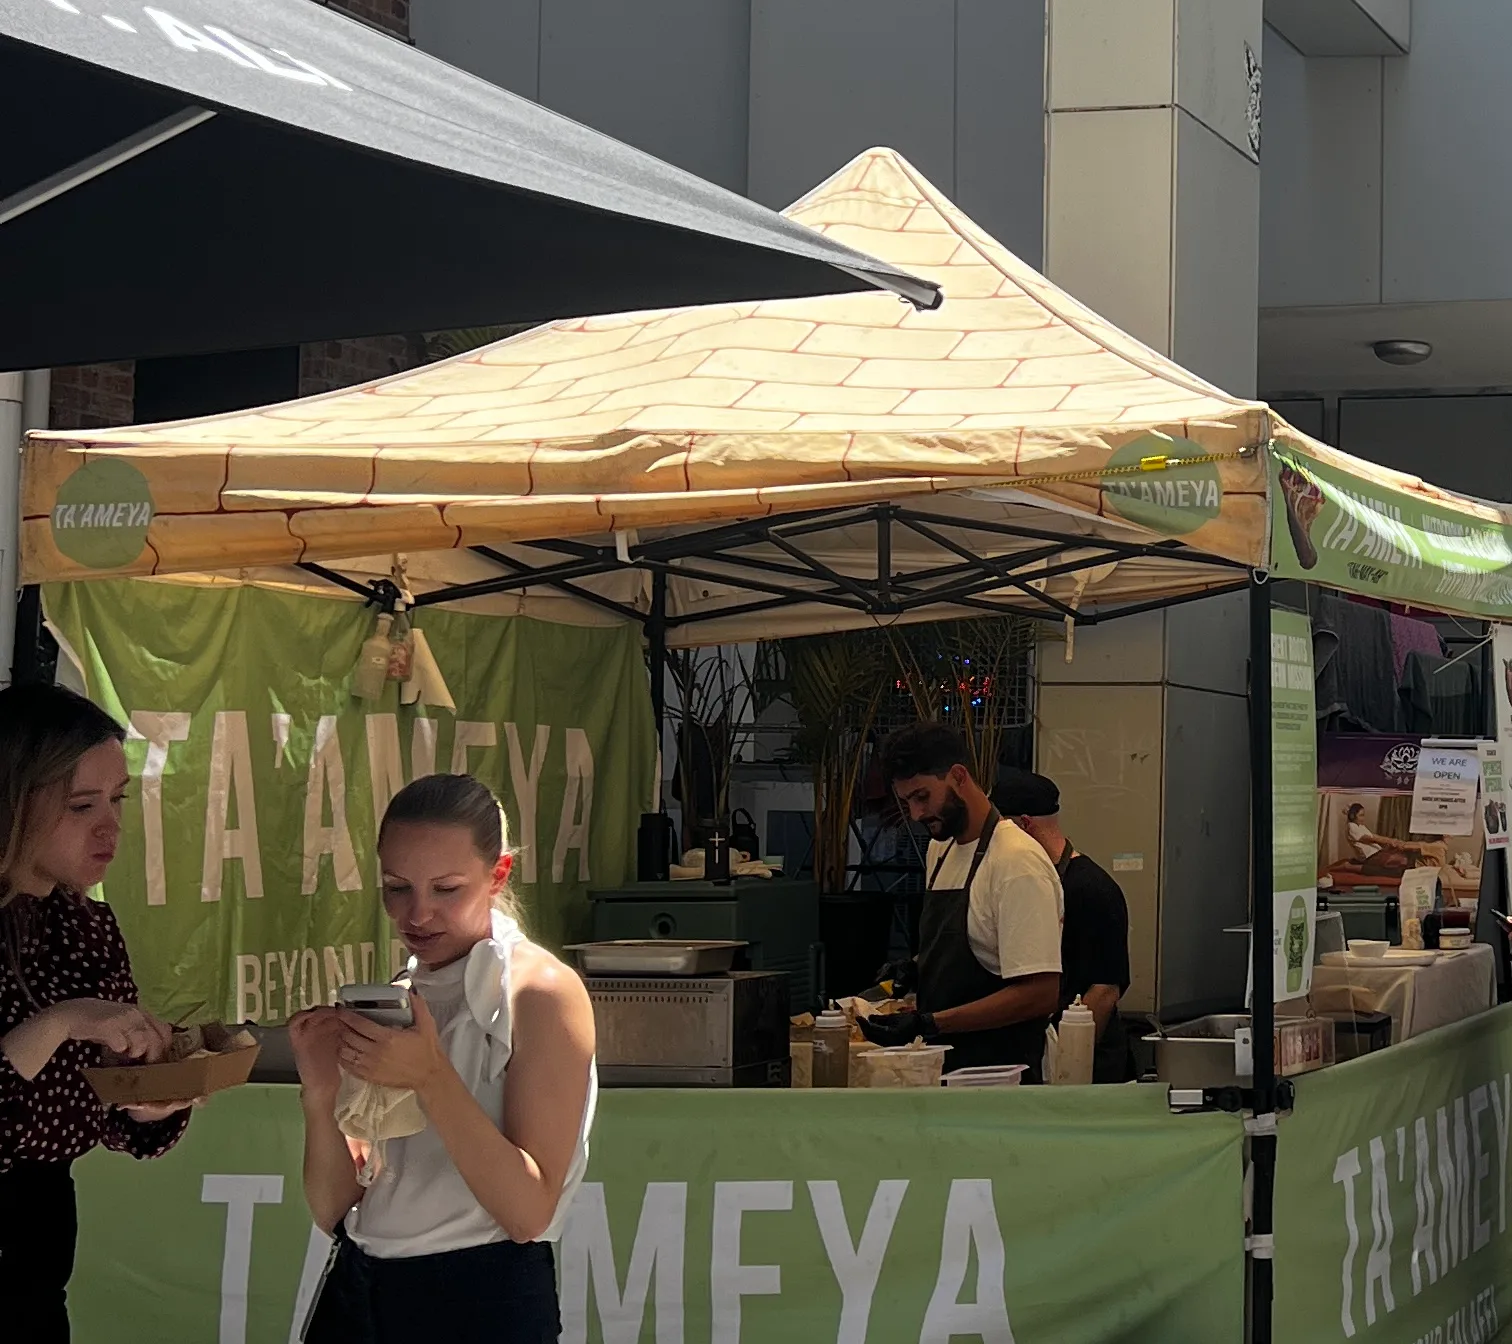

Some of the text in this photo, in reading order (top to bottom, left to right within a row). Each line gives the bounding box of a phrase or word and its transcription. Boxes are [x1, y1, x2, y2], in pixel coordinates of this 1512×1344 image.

[1101, 479, 1220, 508] TA'AMEYA
[54, 501, 151, 529] TA'AMEYA
[1431, 757, 1468, 767] WE ARE
[1433, 770, 1461, 780] OPEN
